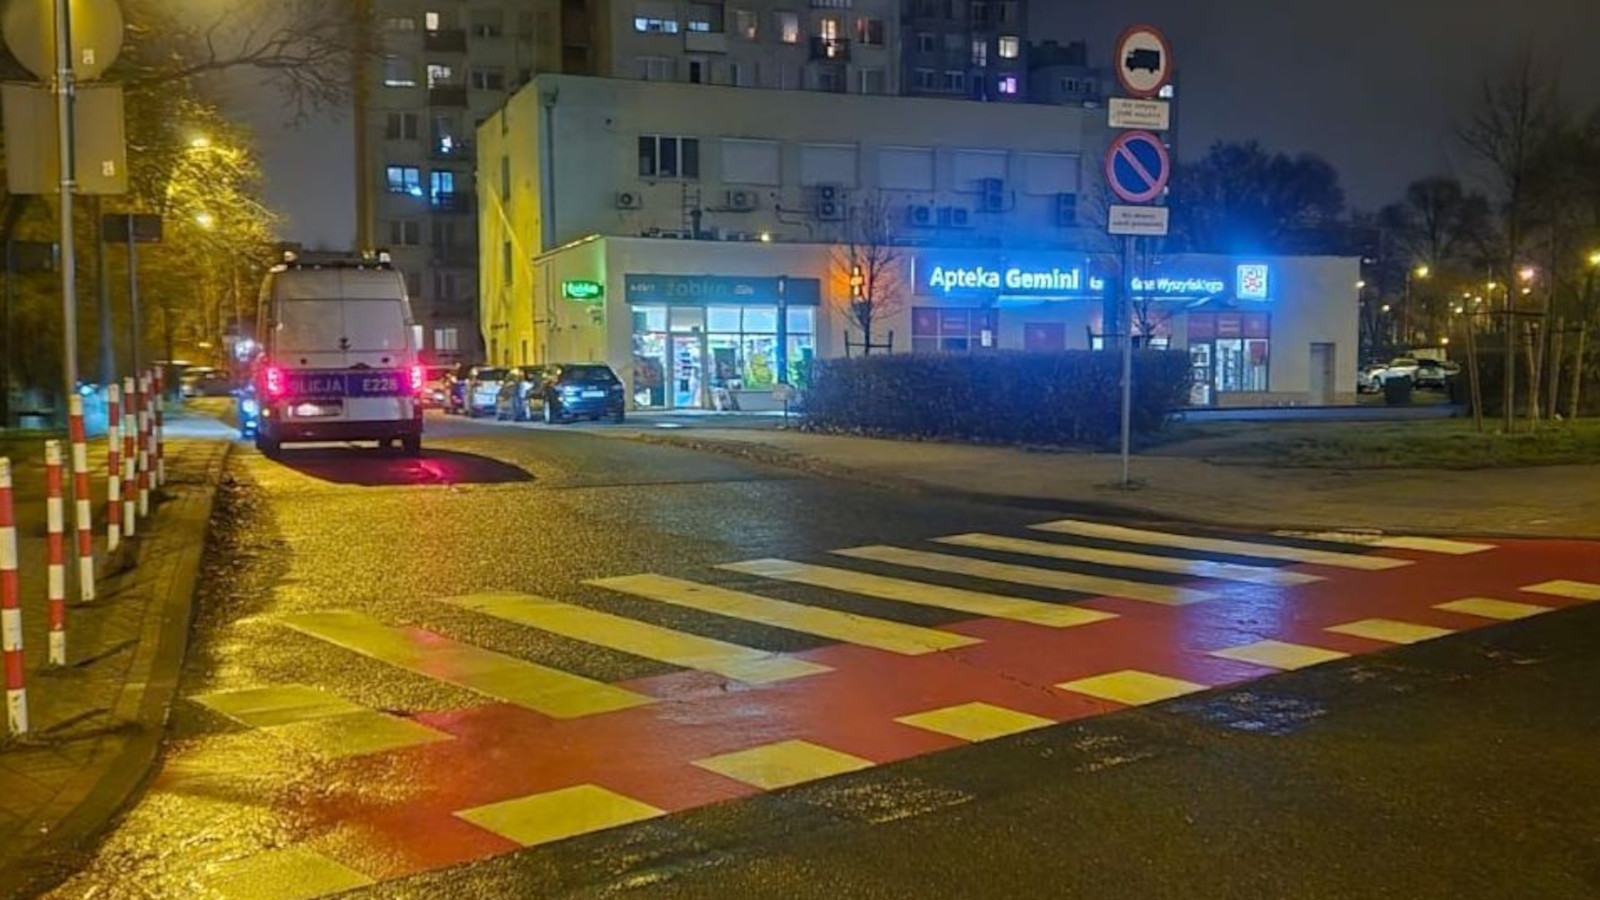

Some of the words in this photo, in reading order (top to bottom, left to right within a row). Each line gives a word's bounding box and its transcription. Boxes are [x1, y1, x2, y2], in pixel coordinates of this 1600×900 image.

[930, 265, 1000, 293] Apteka
[1005, 267, 1080, 290] Gemini
[287, 378, 342, 394] OLICJA
